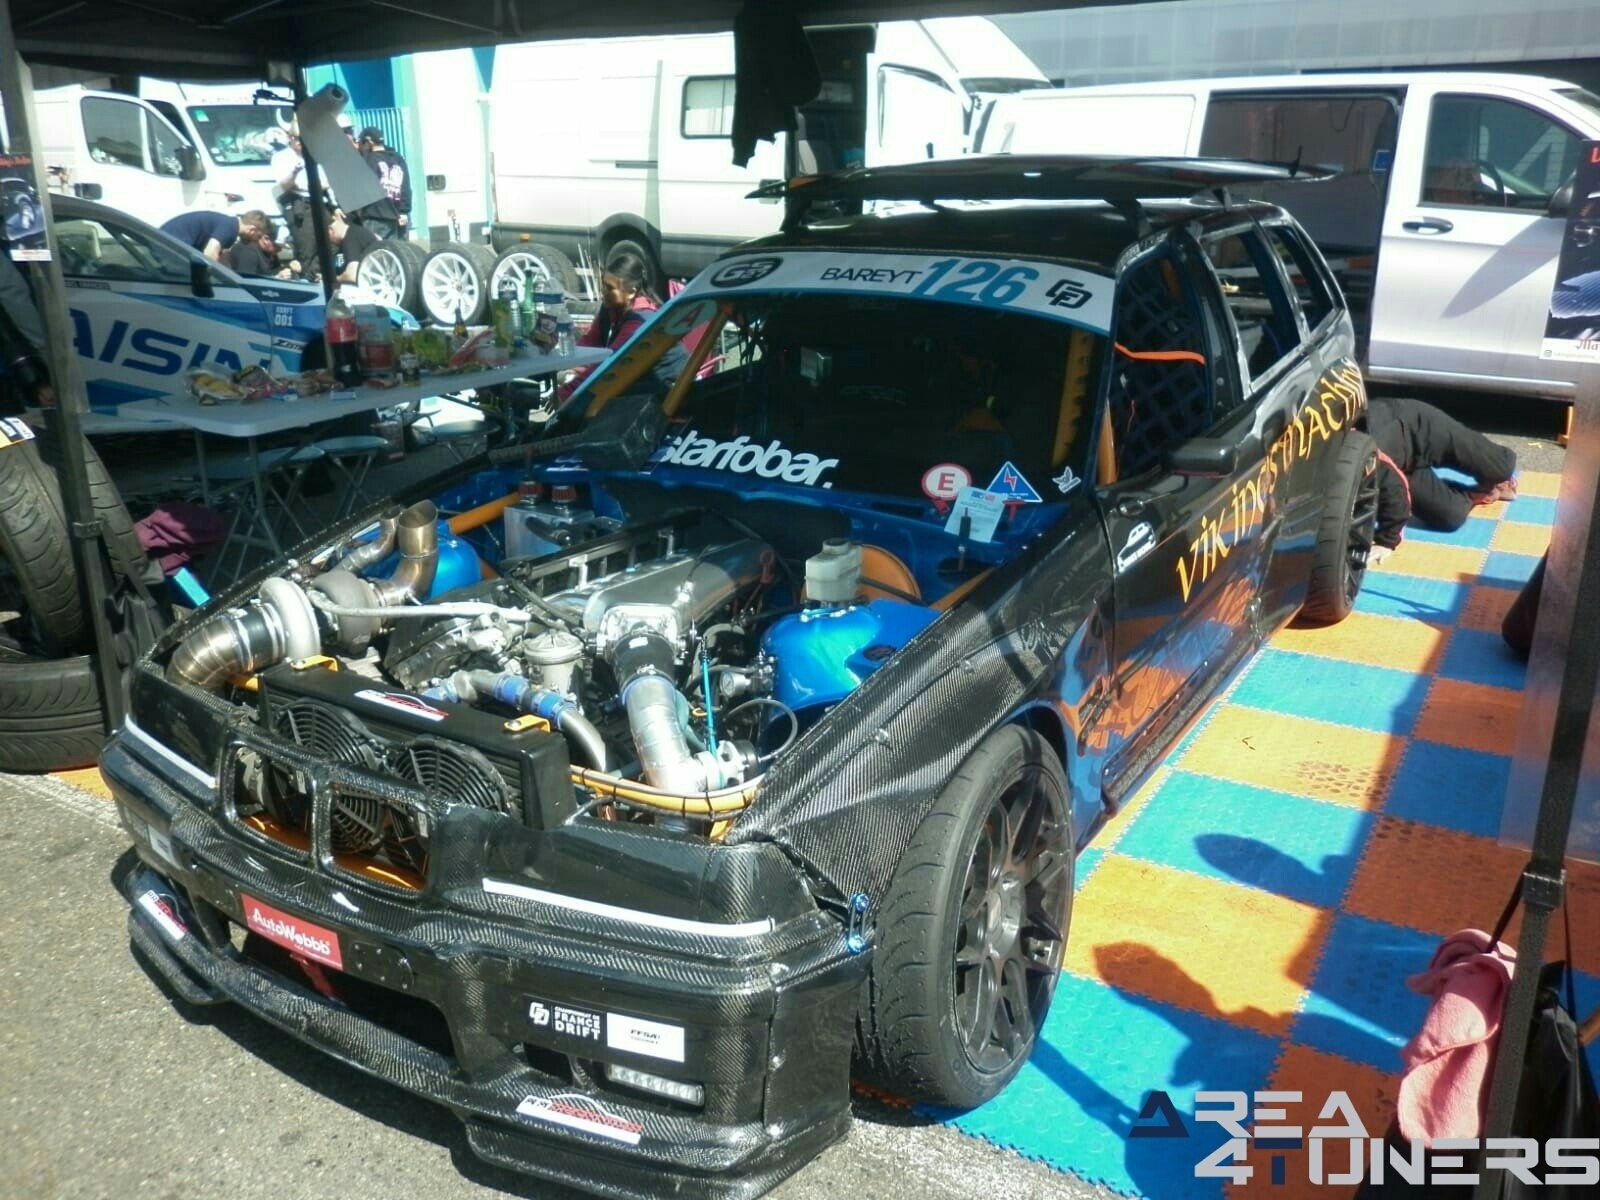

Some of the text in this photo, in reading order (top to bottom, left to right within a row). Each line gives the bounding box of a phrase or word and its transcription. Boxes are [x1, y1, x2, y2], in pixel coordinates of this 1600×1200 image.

[820, 258, 1041, 306] BAREYT 126
[937, 472, 956, 492] E
[554, 1011, 600, 1029] FRANCE
[554, 1020, 601, 1041] DRIFT
